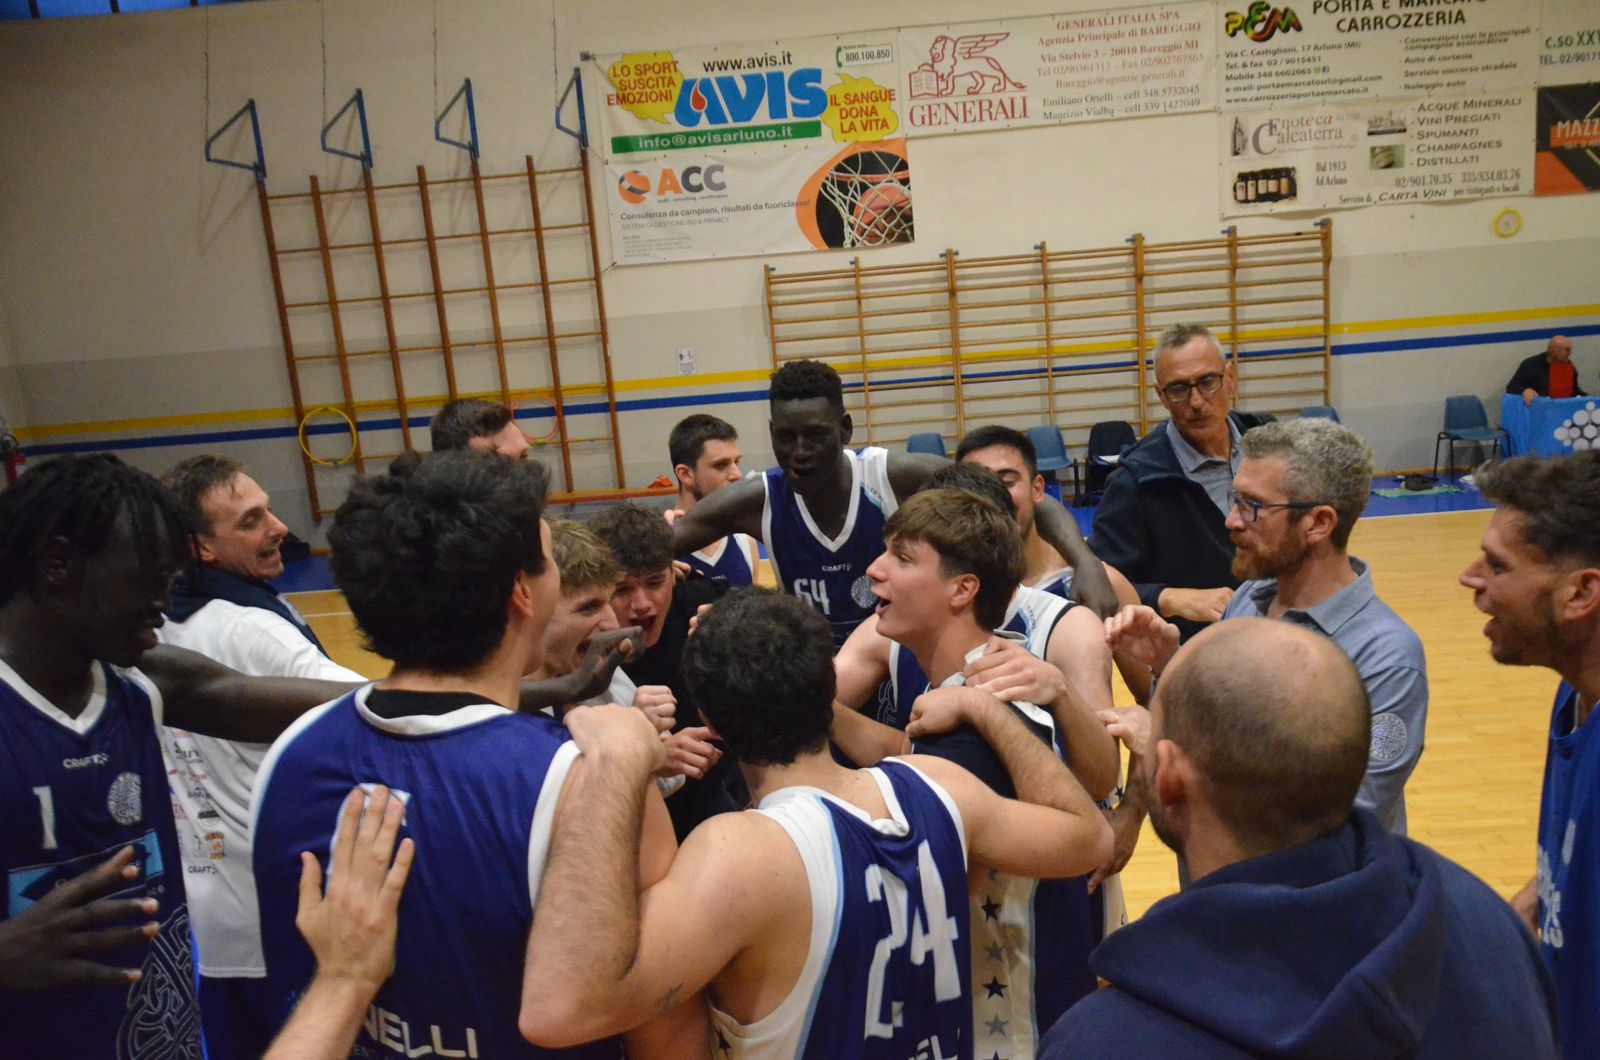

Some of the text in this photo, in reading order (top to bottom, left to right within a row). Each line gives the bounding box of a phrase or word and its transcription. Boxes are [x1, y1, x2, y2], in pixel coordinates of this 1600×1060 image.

[1056, 10, 1180, 30] GENERALI ITALIA SPA
[1336, 9, 1466, 33] CARROZZERIA
[1039, 22, 1201, 47] Agenzia Principale di BAREGGIO
[845, 48, 891, 62] 800.100.850
[1040, 53, 1057, 62] Via
[1059, 51, 1091, 61] Stelvio
[1093, 49, 1099, 58] 3
[1110, 46, 1137, 57] 20010
[1140, 42, 1182, 54] Bareggio
[1184, 40, 1199, 50] MI
[1313, 42, 1343, 51] Arluno
[612, 60, 679, 78] LO SPORT
[702, 50, 793, 73] www.avis.it
[1225, 61, 1240, 71] Tel.
[1249, 60, 1263, 68] fax
[1266, 59, 1278, 67] 02
[619, 76, 676, 91] SUSCITA
[1225, 72, 1255, 82] Mobile
[607, 90, 673, 106] EMOZIONI
[674, 67, 828, 127] AVIS
[829, 88, 897, 107] IL SANGUE
[1042, 96, 1083, 107] Emiliano
[1085, 92, 1114, 103] Ortelli
[1124, 88, 1140, 100] cell
[840, 105, 879, 120] DONA
[909, 96, 1031, 128] GENERALI
[1043, 108, 1083, 120] Maurizio
[1124, 103, 1140, 113] cell
[840, 118, 890, 133] LA VITA
[1268, 112, 1334, 136] Enoteca
[639, 126, 794, 149] info@avisarluno.it
[1252, 122, 1344, 156] Calcaterra
[656, 164, 727, 196] ACC
[1378, 191, 1418, 202] CARTA
[620, 209, 668, 220] Consulenza
[669, 209, 679, 217] da
[680, 205, 720, 217] campioni,
[721, 202, 751, 213] risultati
[753, 203, 763, 211] da
[822, 563, 847, 572] CRAFT
[62, 754, 98, 769] CRAFT
[32, 785, 58, 850] 1
[188, 865, 211, 874] CRAFT
[864, 838, 962, 1041] 24
